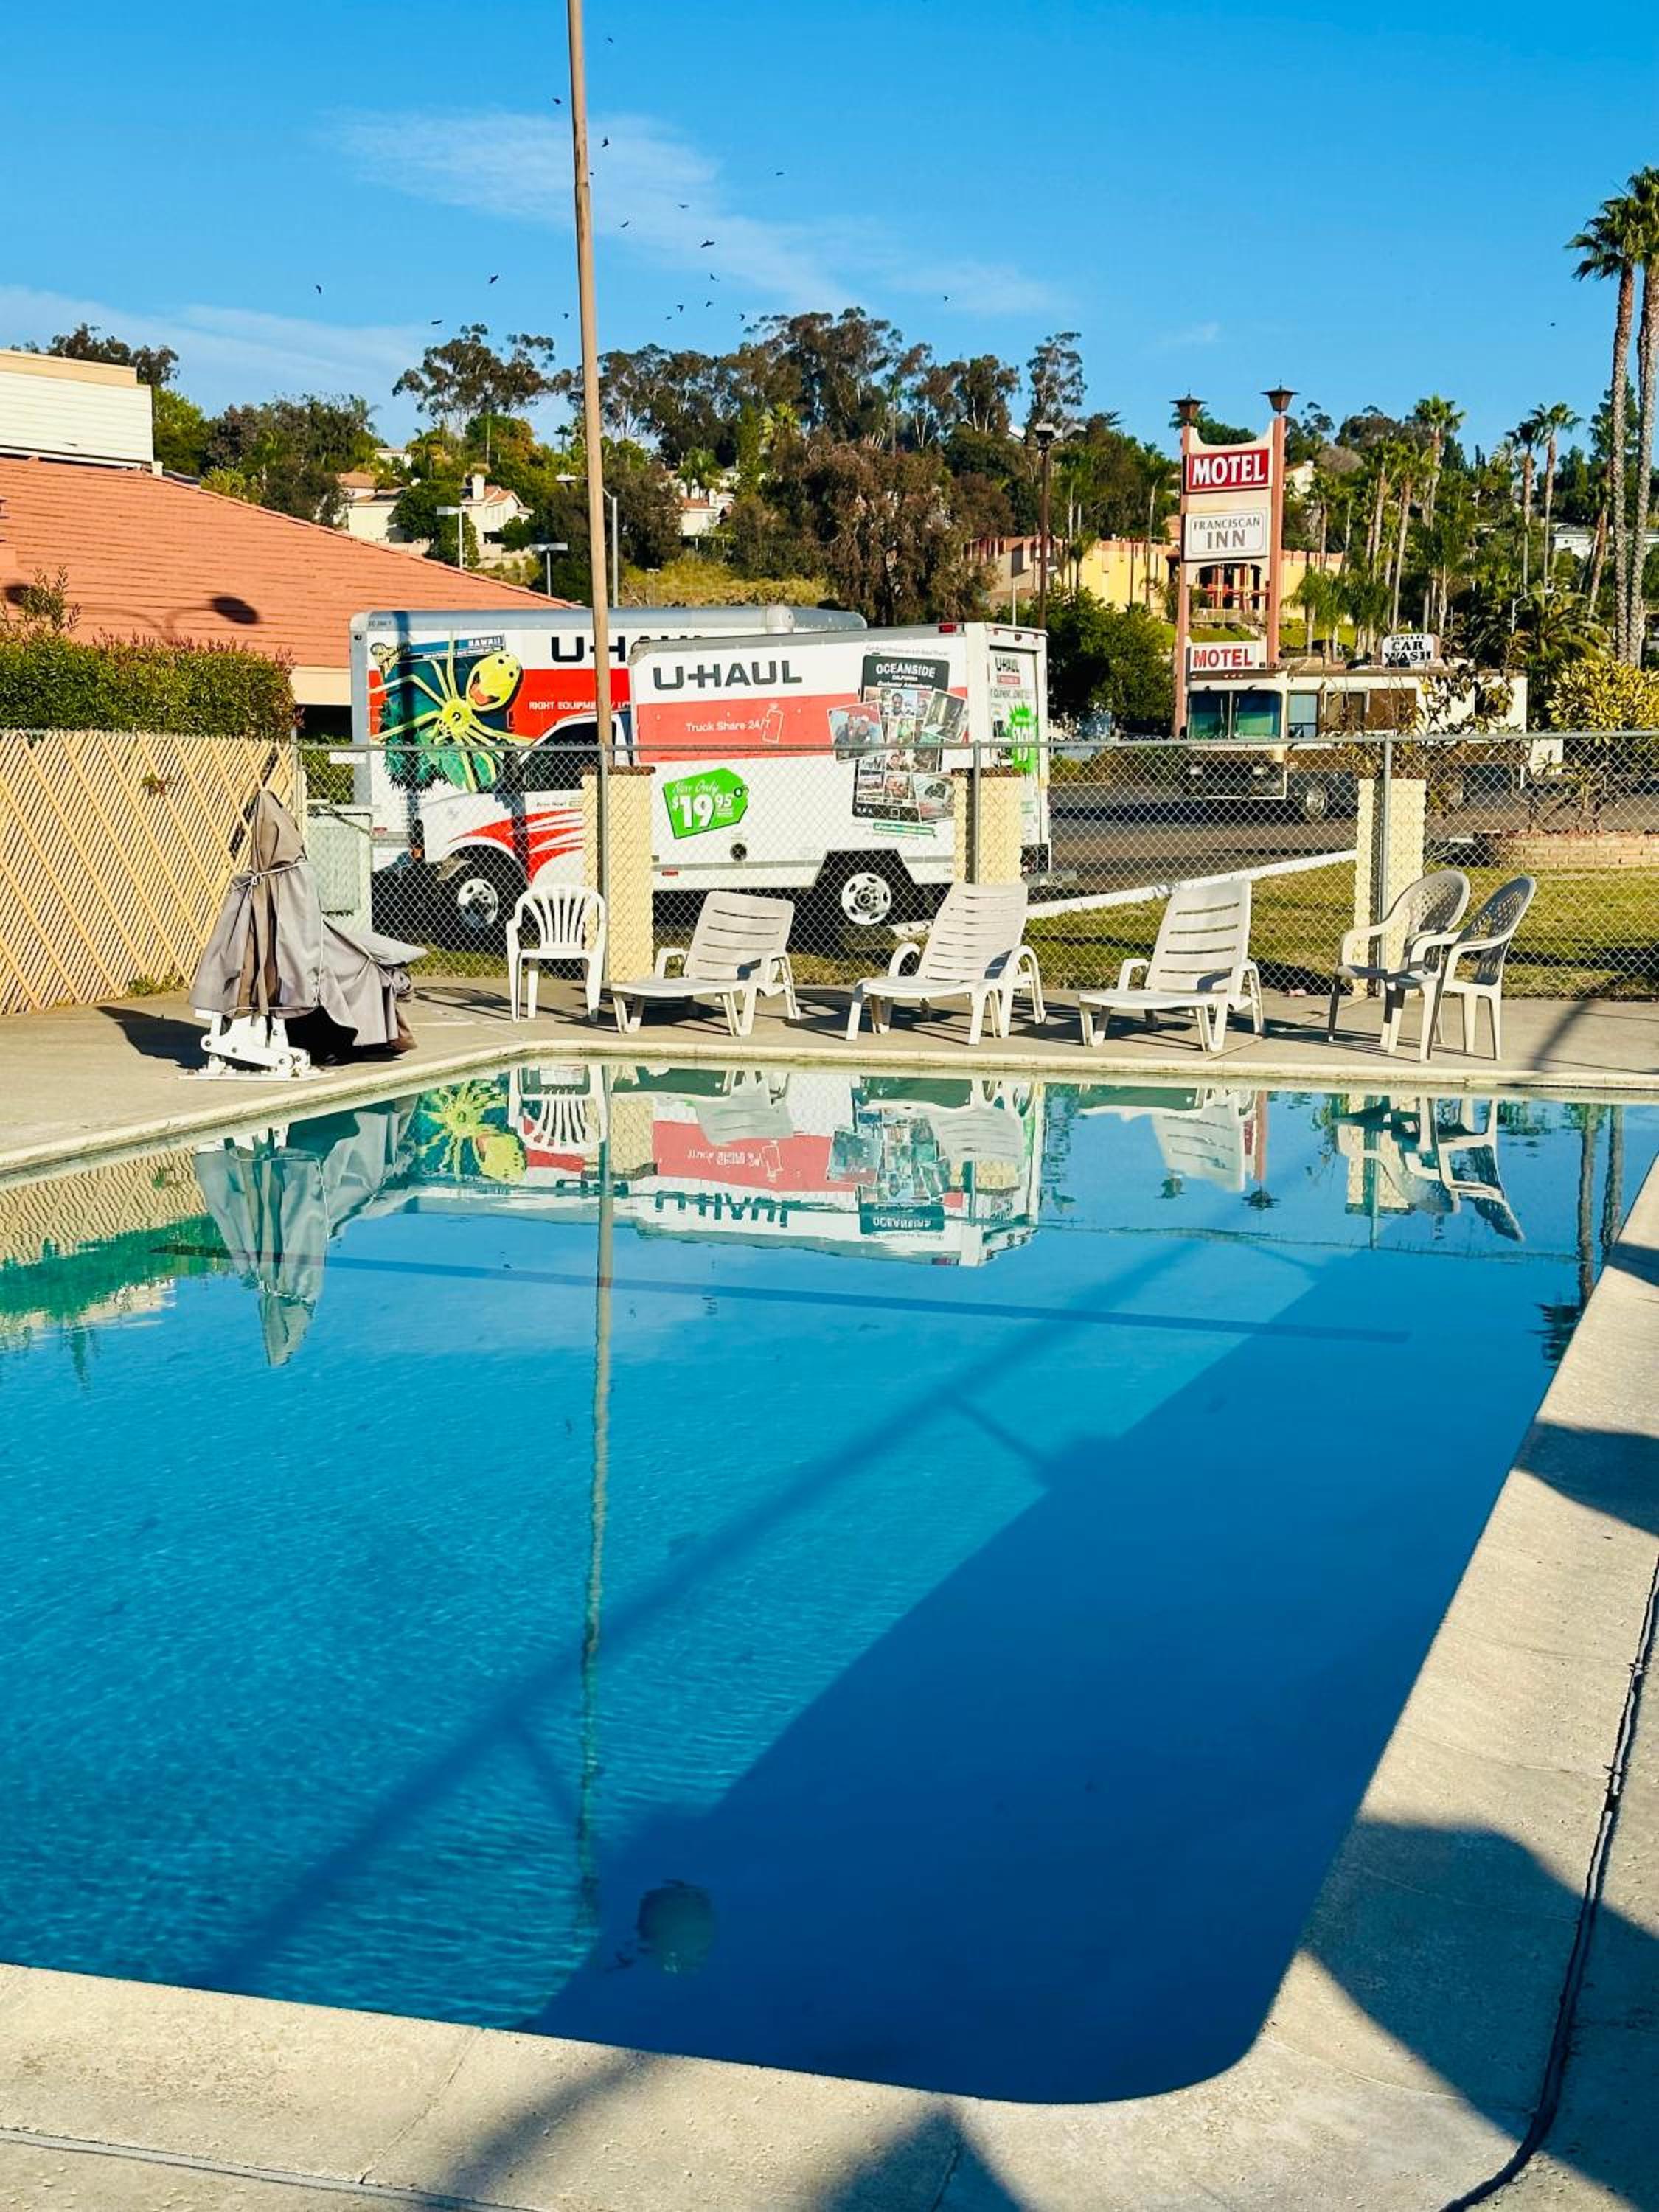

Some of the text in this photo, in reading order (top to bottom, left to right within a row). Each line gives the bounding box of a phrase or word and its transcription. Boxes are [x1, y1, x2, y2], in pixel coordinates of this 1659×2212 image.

[1192, 453, 1265, 486] MOTEL
[1193, 516, 1261, 531] FRANCISCAN
[1206, 529, 1246, 549] INN
[468, 636, 501, 647] HAWAII
[1392, 641, 1423, 651] CAR
[1193, 647, 1253, 668] MOTEL
[1384, 651, 1432, 661] WASH
[653, 660, 803, 691] U-HAUL
[875, 662, 936, 678] OCEANSIDE
[529, 700, 596, 710] RIGHT EQUIPME
[686, 718, 771, 732] Truck Share 24/7
